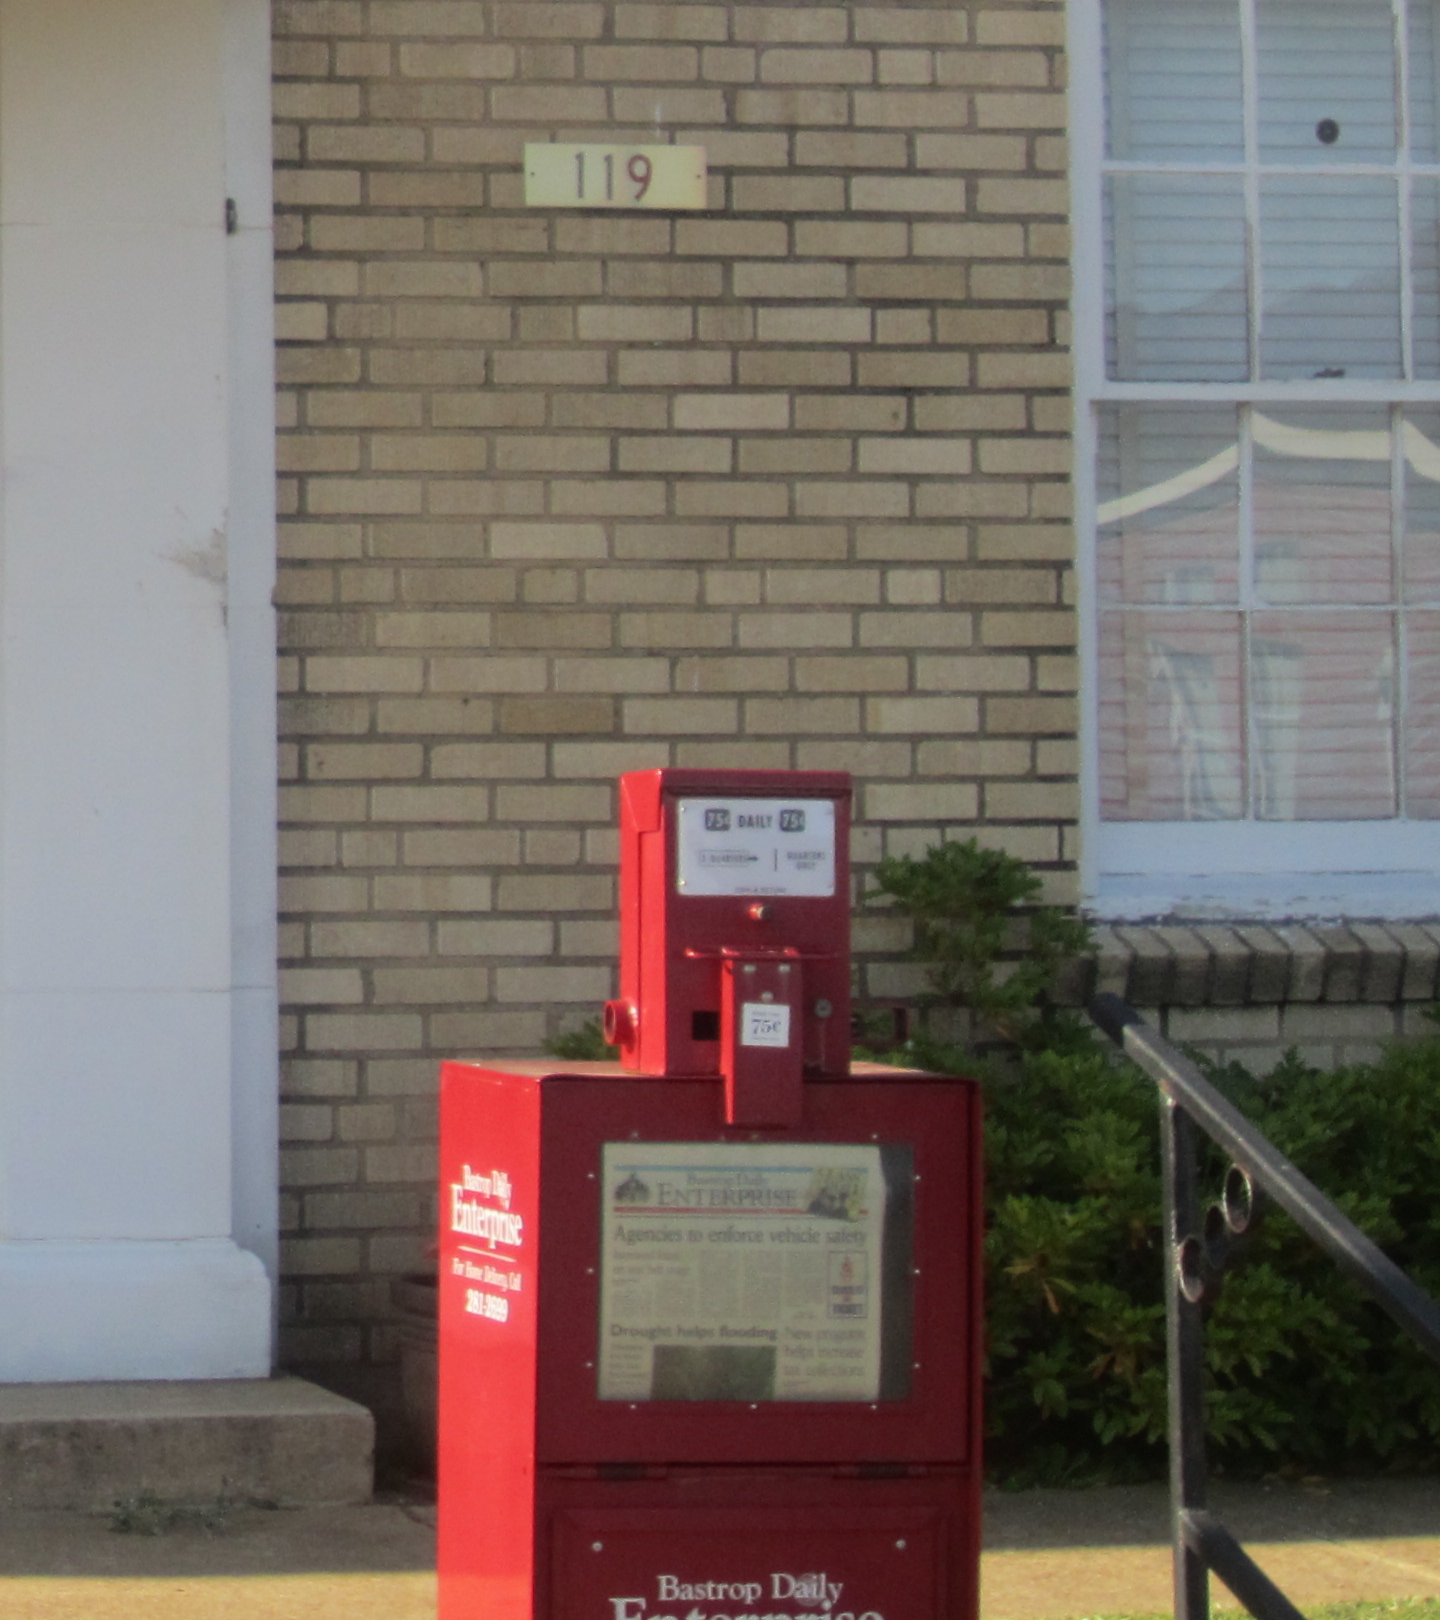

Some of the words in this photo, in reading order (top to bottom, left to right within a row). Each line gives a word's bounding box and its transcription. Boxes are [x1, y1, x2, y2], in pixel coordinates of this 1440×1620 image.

[575, 152, 652, 202] 119
[738, 814, 773, 828] DAILY
[462, 1164, 491, 1199] Bastrop
[491, 1170, 512, 1210] Daily
[451, 1183, 523, 1249] Enterprise
[656, 1574, 762, 1604] Bastrop
[770, 1573, 843, 1603] Daily
